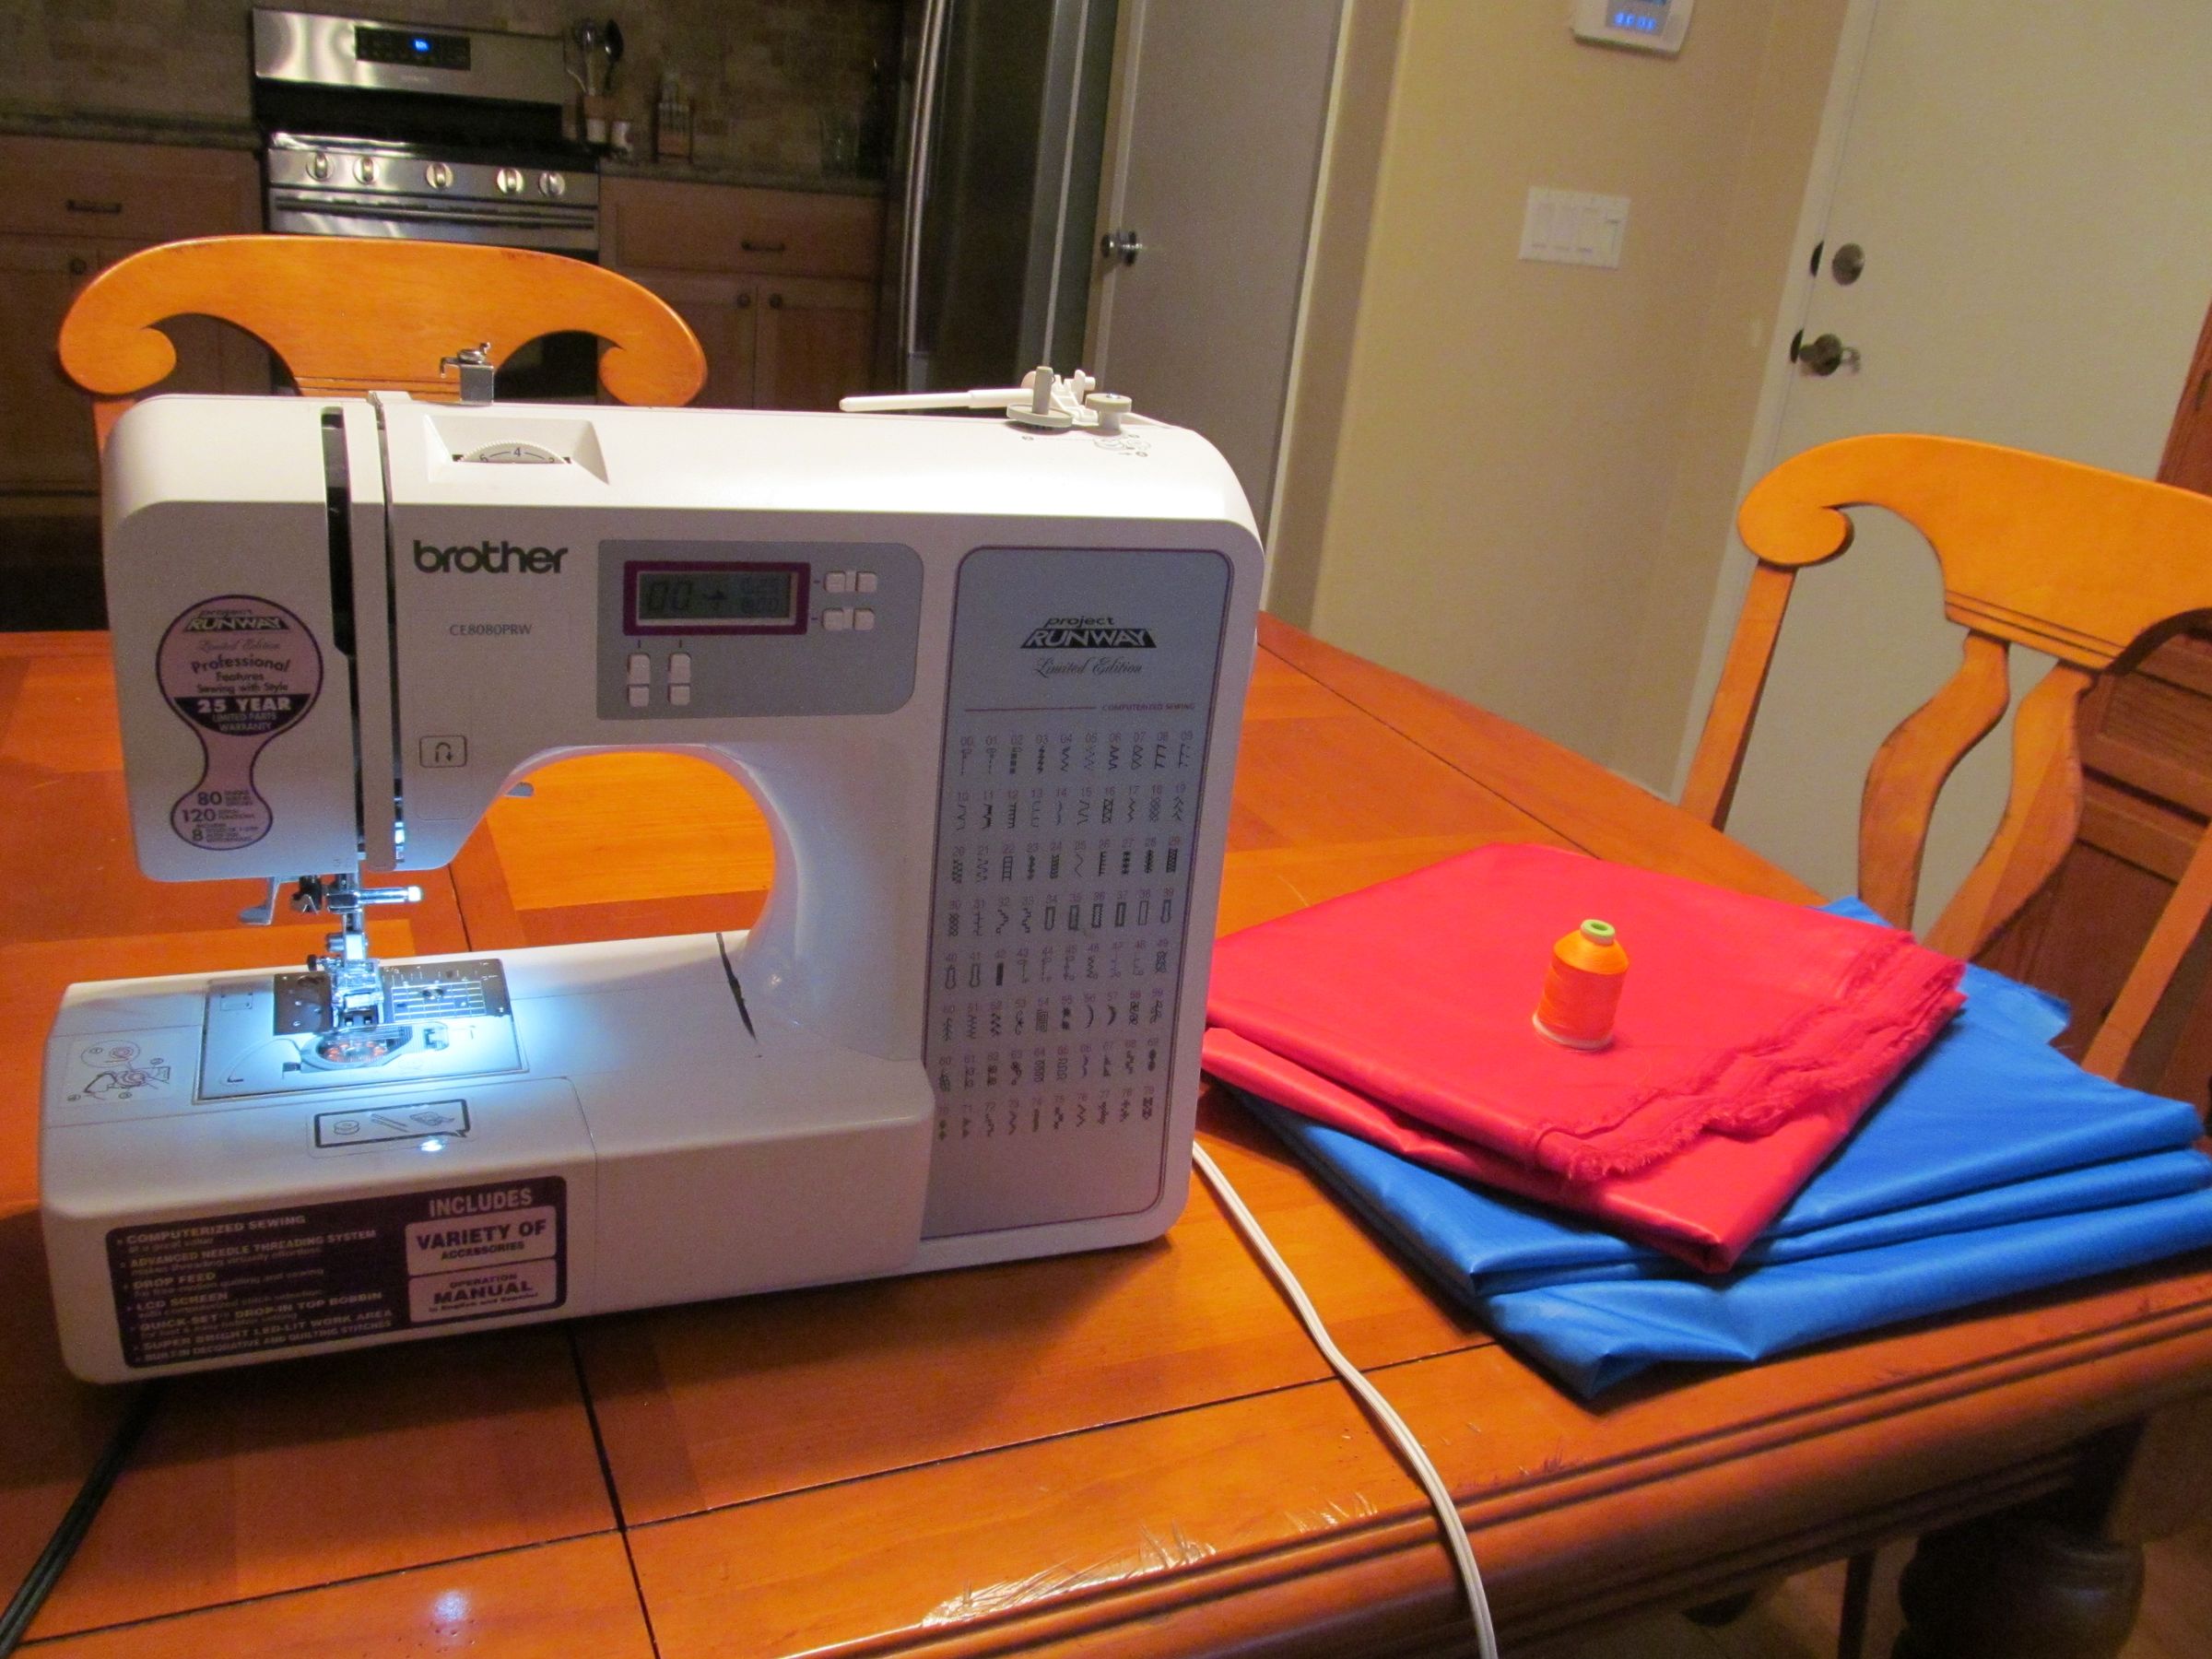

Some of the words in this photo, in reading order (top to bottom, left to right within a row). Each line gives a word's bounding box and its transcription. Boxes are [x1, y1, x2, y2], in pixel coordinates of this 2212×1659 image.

[513, 446, 522, 457] 4
[412, 539, 570, 574] brother
[186, 617, 282, 630] RUNWAY
[449, 623, 533, 636] CE8080PRW
[1042, 616, 1115, 629] project
[1027, 629, 1148, 647] RUNWAY
[190, 653, 291, 675] Professional
[1033, 656, 1093, 679] Limited
[1092, 655, 1144, 676] Edition
[216, 671, 265, 682] Features
[264, 681, 288, 693] Style
[197, 699, 227, 713] 25
[236, 697, 292, 712] YEAR
[212, 712, 247, 724] LIMITED
[249, 712, 277, 722] PARTS
[219, 722, 273, 731] WARRANTY
[197, 791, 223, 806] 80
[181, 807, 217, 823] 120
[192, 829, 204, 841] 8
[428, 1187, 533, 1218] INCLUDES
[126, 1222, 245, 1244] COMPUTERIZED
[249, 1215, 307, 1230] SEWING
[416, 1223, 512, 1251] VARIETY
[518, 1218, 547, 1237] OF
[131, 1252, 199, 1268] ADVANCED
[201, 1244, 251, 1259] NEEDLE
[253, 1236, 324, 1253] THREADING
[326, 1230, 377, 1243] SYSTEM
[441, 1240, 526, 1261] ACCESSORIES
[132, 1277, 174, 1290] DROP
[178, 1271, 217, 1285] FEED
[449, 1273, 518, 1289] OPERATION
[433, 1280, 535, 1304] MANUAL
[136, 1299, 167, 1312] LCD
[170, 1291, 229, 1307] SCREEN
[235, 1303, 293, 1319] DROP-IN
[296, 1299, 325, 1311] TOP
[328, 1291, 382, 1306] BOBBIN
[310, 1314, 352, 1328] WORK
[356, 1309, 394, 1321] AREA
[288, 1327, 339, 1342] QUILTING
[340, 1320, 392, 1335] STITCHES
